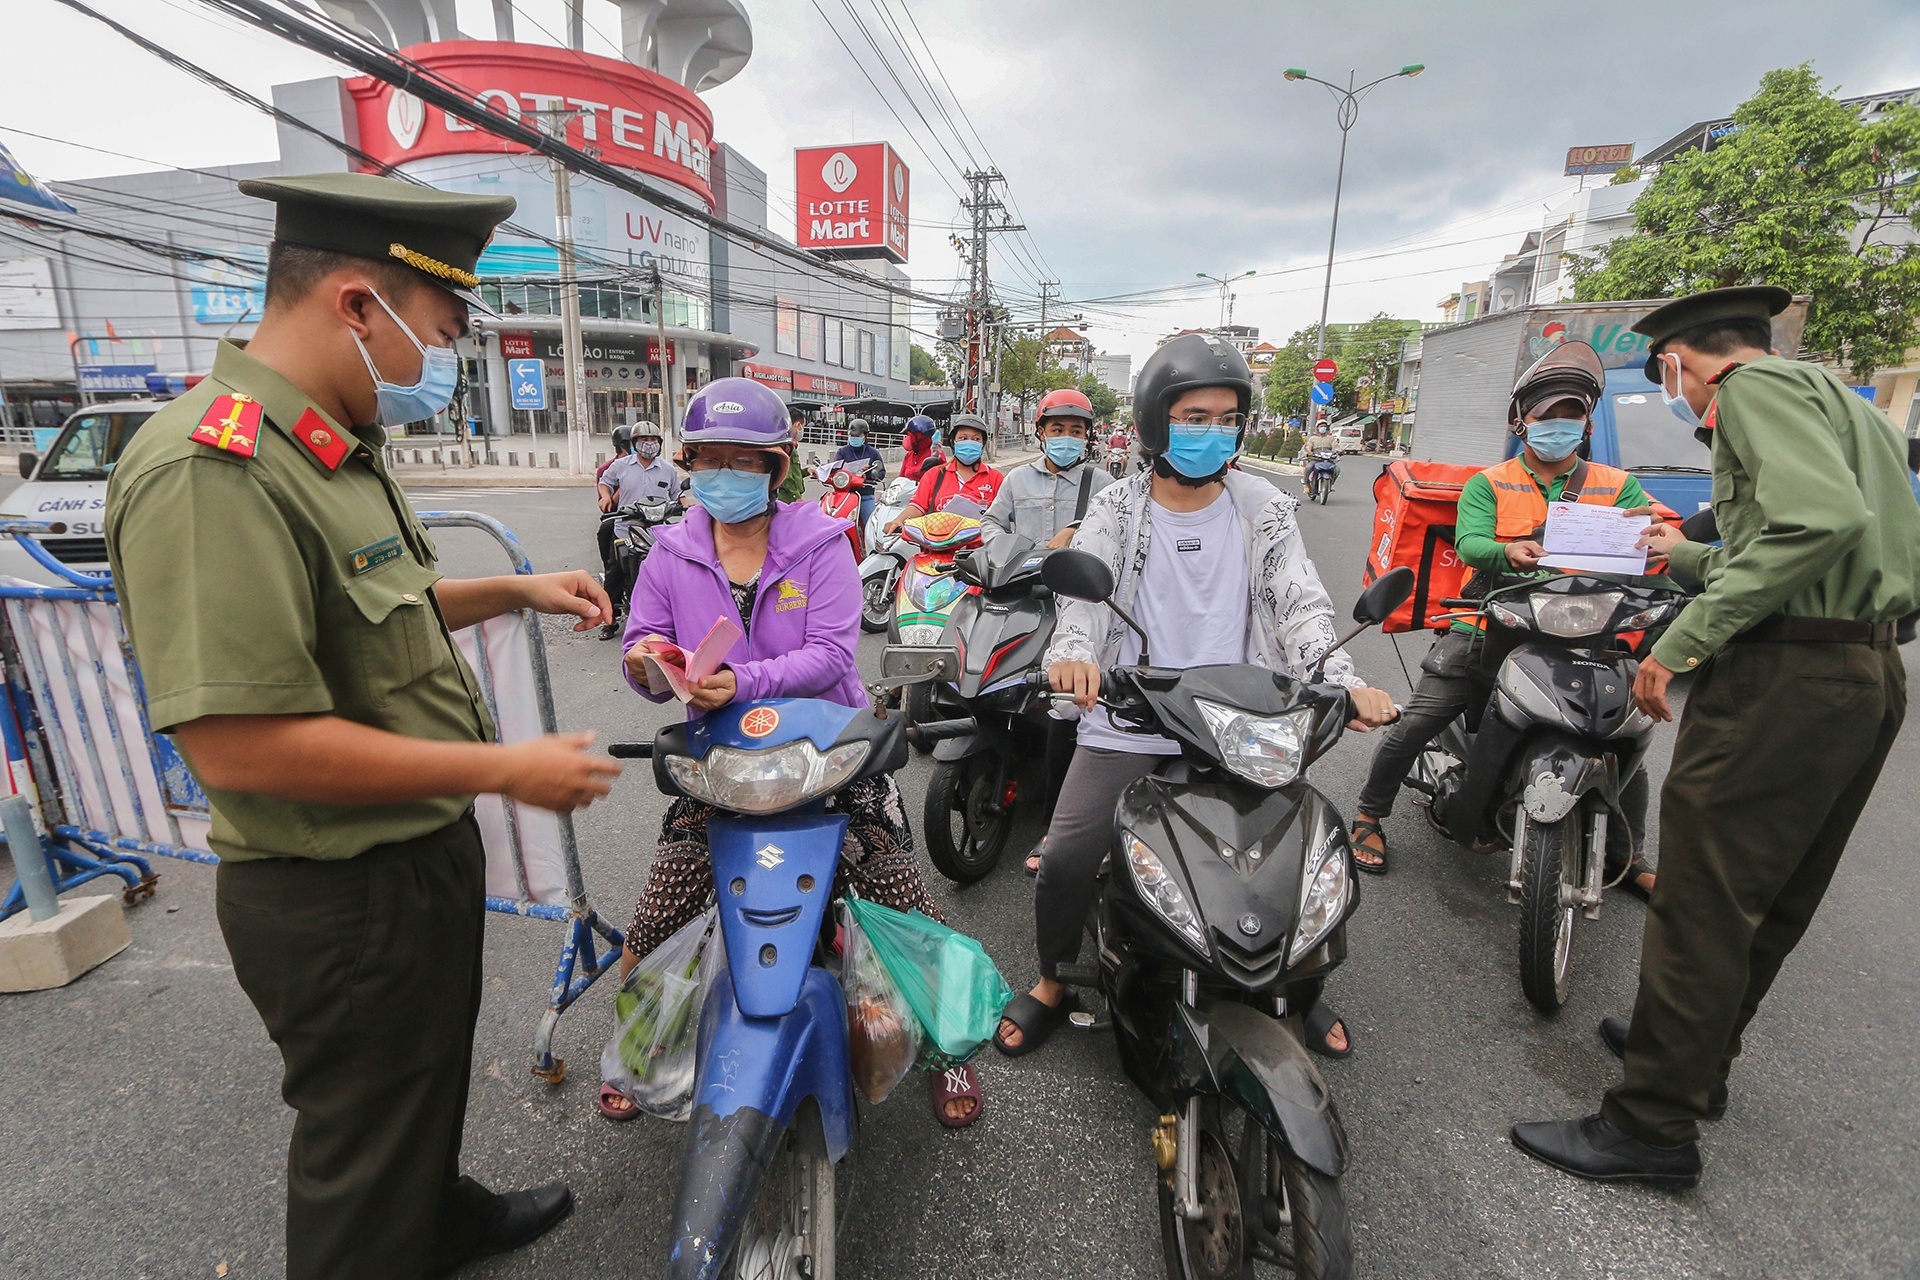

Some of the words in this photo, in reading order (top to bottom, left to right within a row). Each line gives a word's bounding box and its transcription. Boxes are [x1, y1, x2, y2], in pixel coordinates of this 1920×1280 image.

[1569, 145, 1629, 165] HOTEL
[809, 199, 870, 216] LOTTE
[890, 203, 906, 230] LOTTE
[810, 217, 870, 240] Mart
[890, 221, 906, 252] Mart
[627, 248, 653, 268] LG
[505, 345, 531, 355] Mart
[715, 403, 741, 411] Asia
[38, 497, 86, 512] CẢNH
[1572, 660, 1611, 670] HONDA
